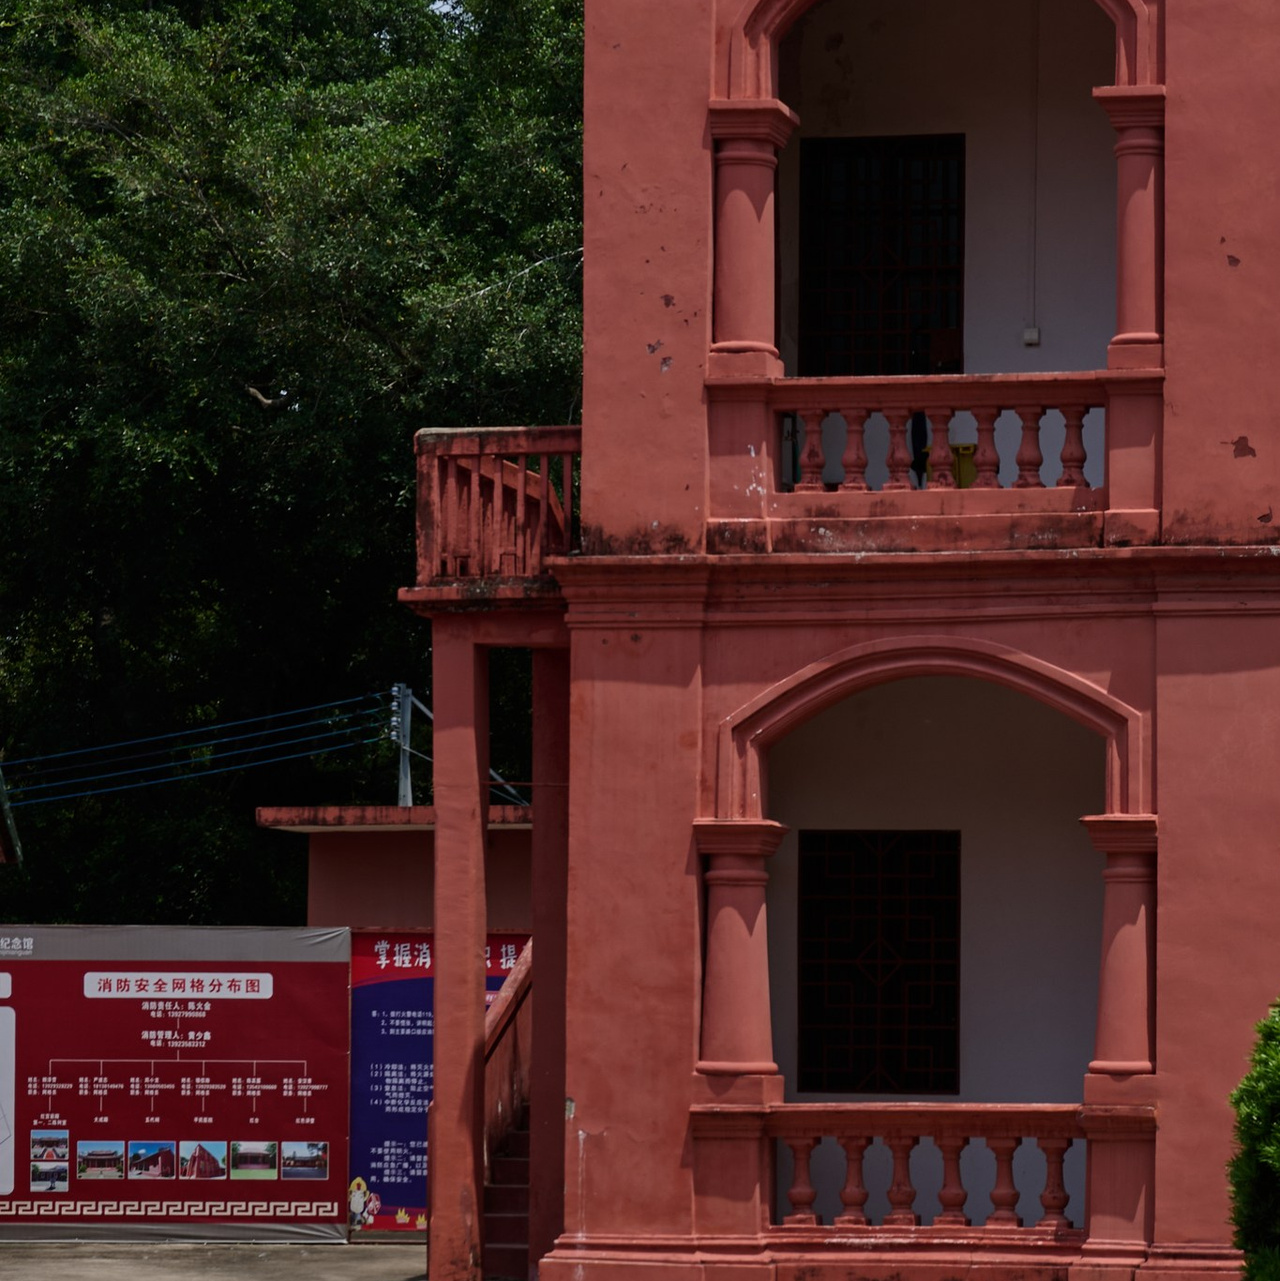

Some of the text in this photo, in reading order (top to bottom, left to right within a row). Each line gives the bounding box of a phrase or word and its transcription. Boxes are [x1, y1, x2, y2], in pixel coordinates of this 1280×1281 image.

[97, 978, 261, 994] 消防安全网格分布图
